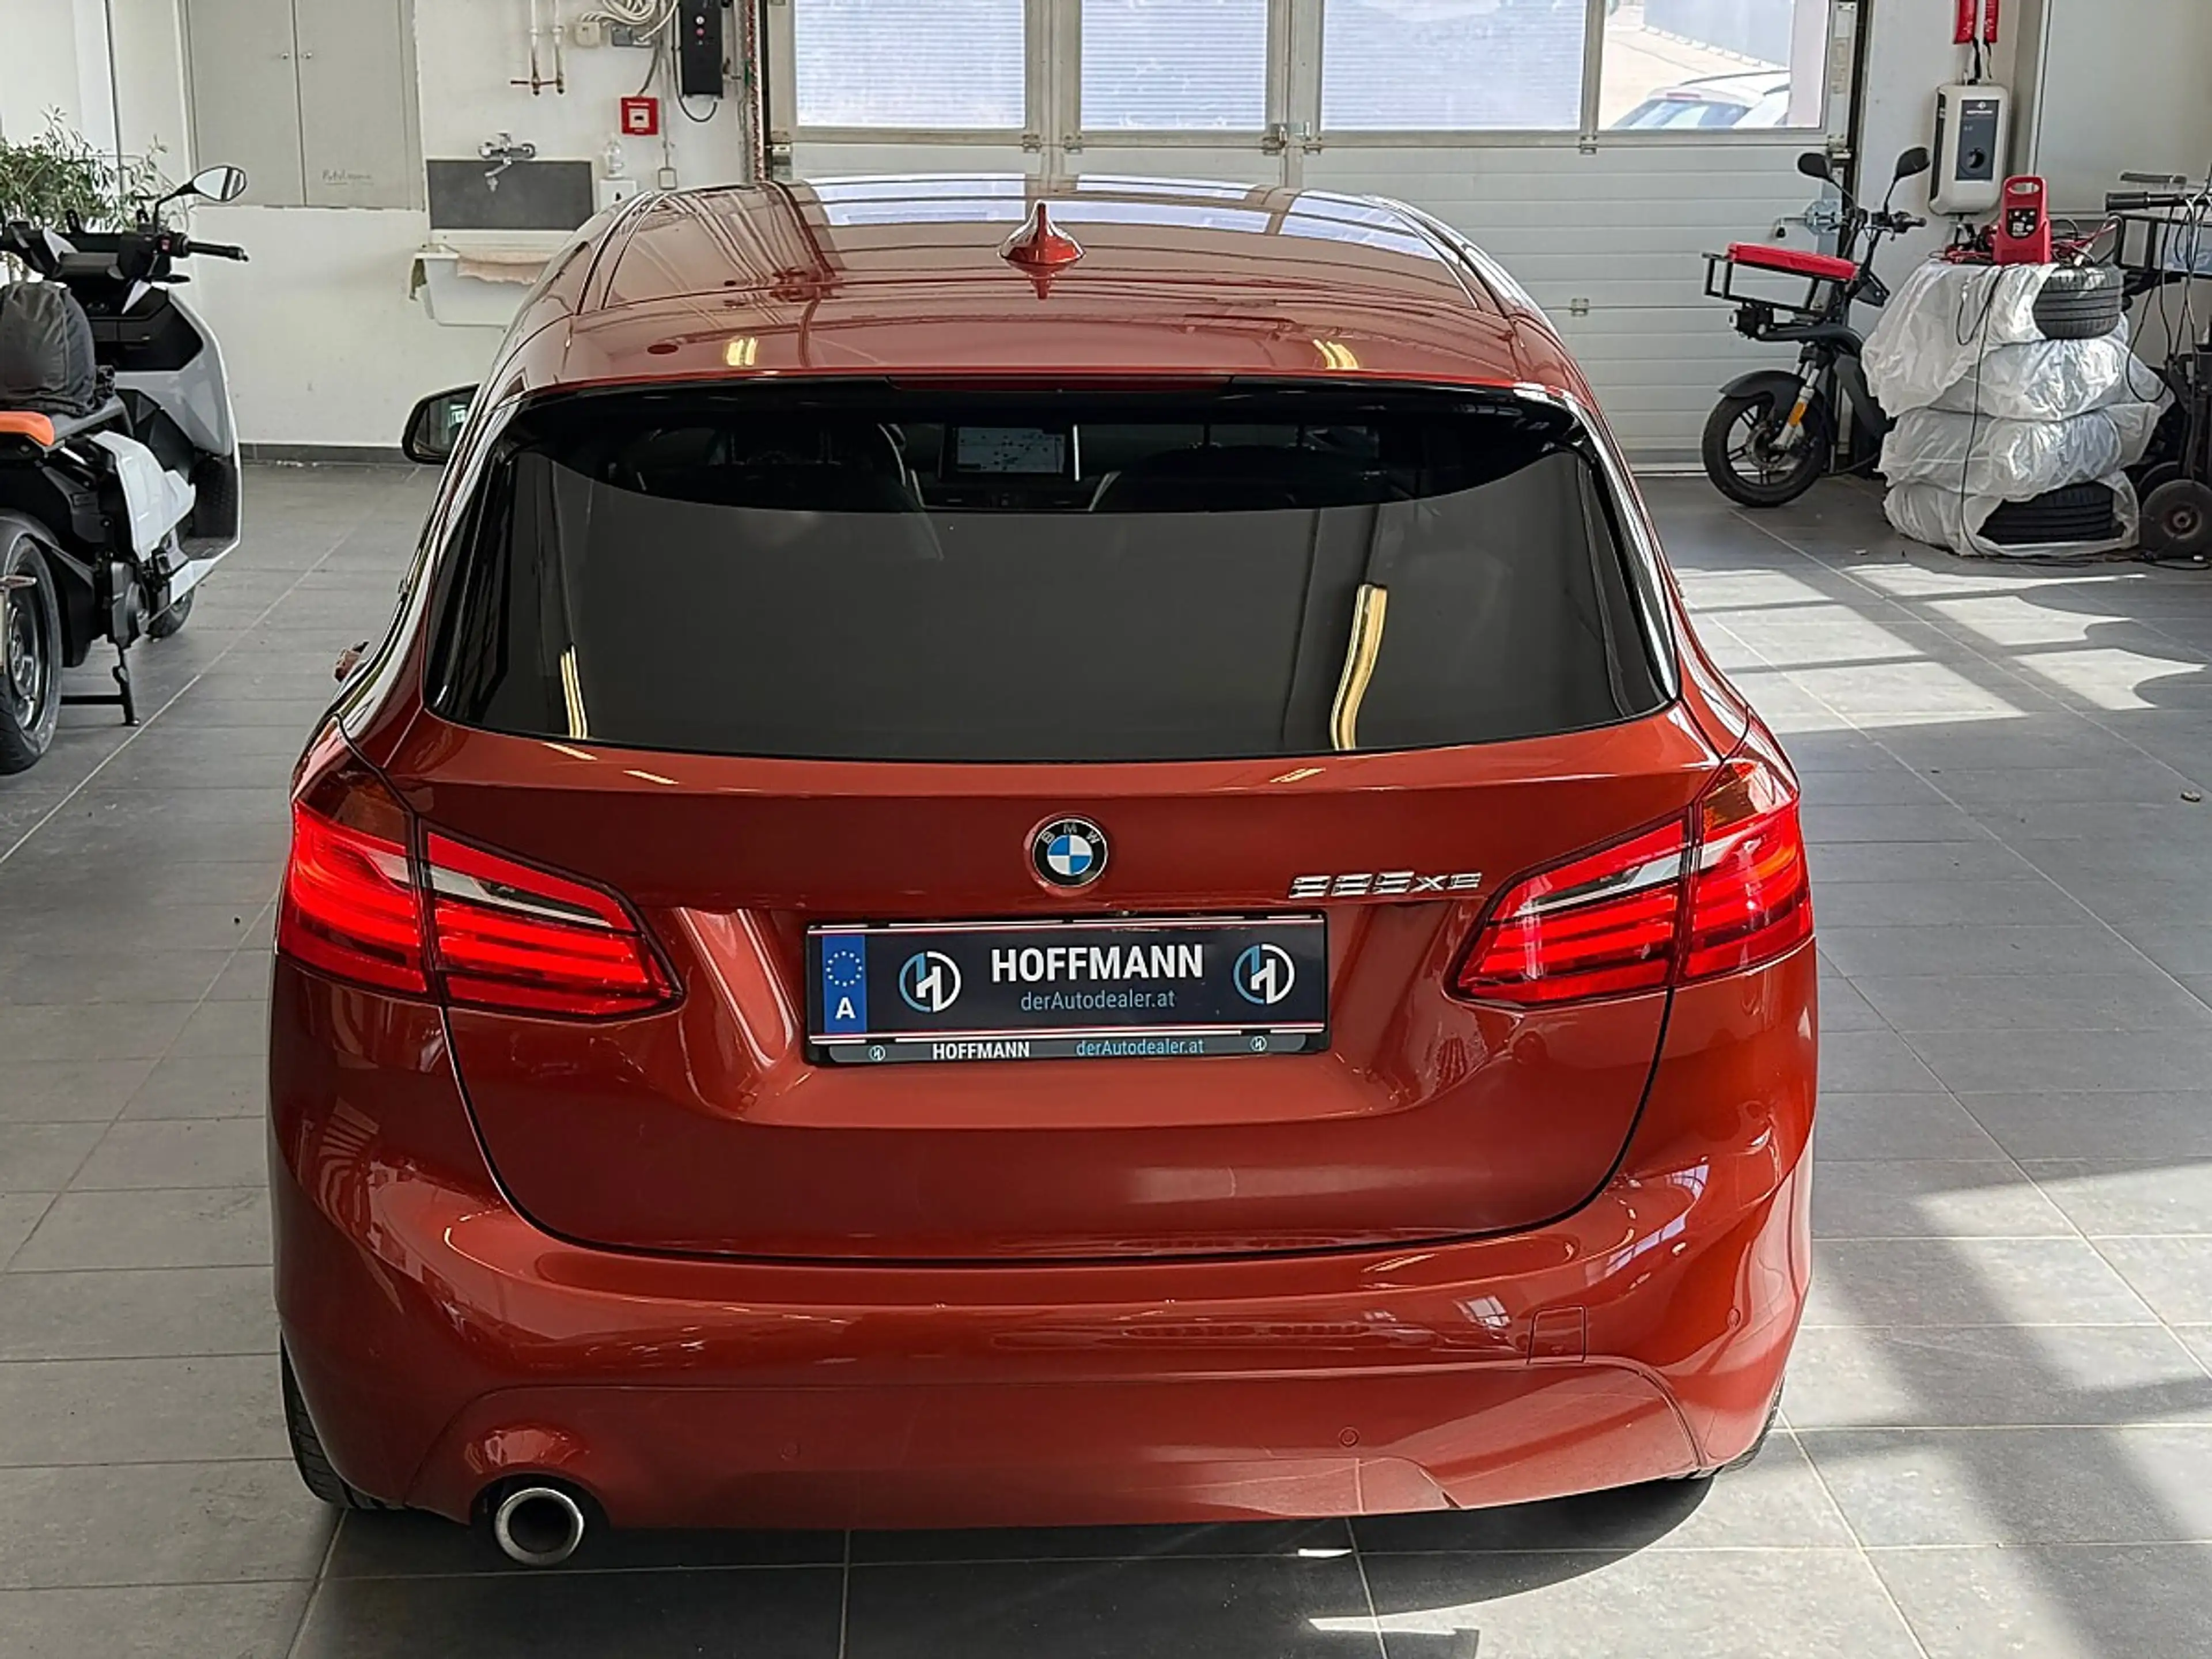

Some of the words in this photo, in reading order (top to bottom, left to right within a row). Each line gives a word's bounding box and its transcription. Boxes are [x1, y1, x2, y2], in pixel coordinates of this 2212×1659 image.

[1040, 823, 1100, 845] BMW
[991, 944, 1203, 983] HOFFMANN
[835, 997, 857, 1019] A
[1021, 988, 1175, 1010] derAutodealer.at
[932, 1041, 1031, 1060] HOFFMANN
[1076, 1038, 1205, 1056] derAutodealer.at
